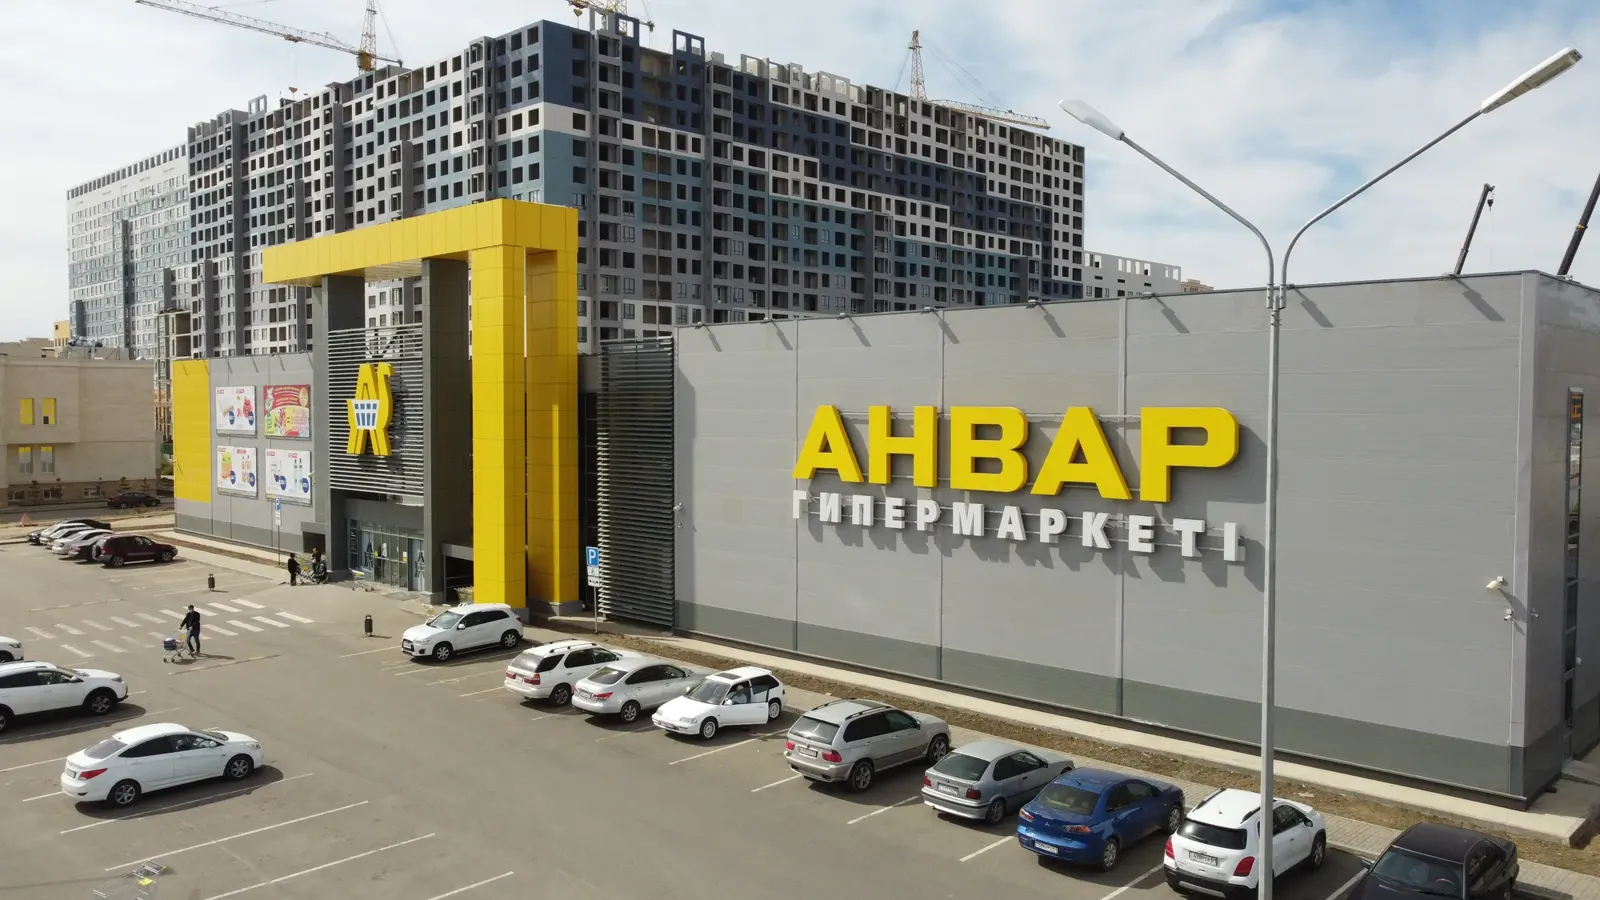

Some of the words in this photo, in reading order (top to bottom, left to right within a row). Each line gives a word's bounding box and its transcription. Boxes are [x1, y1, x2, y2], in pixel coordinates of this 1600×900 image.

[793, 405, 1239, 502] АНВАР
[588, 549, 597, 565] P
[793, 490, 1239, 562] ГИПЕРМАРКЕТІ
